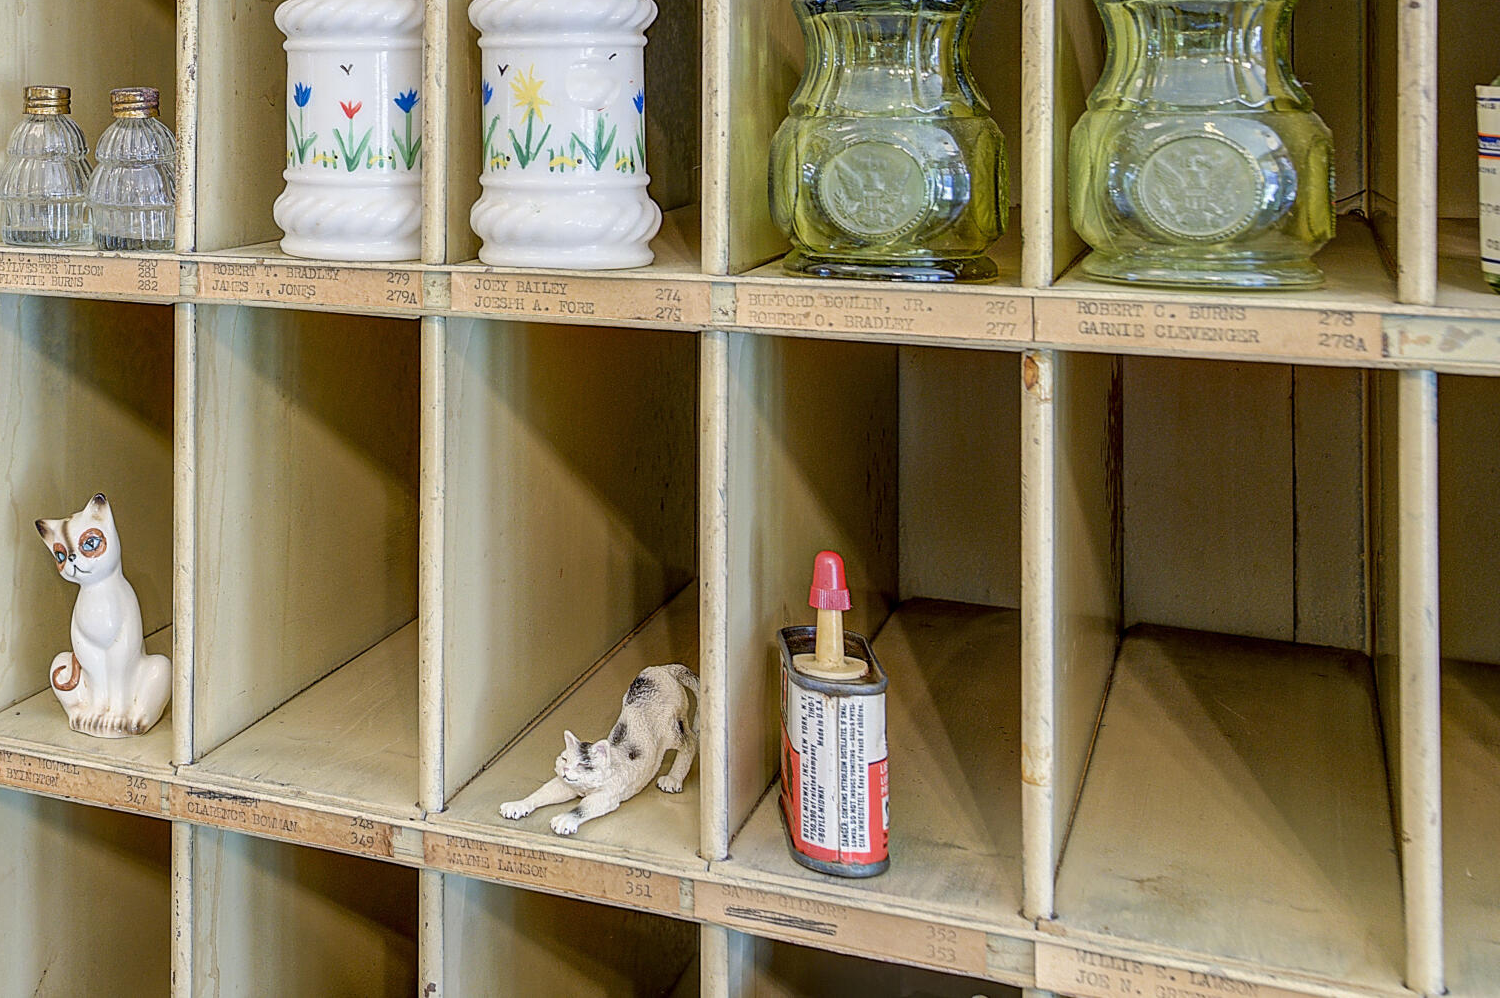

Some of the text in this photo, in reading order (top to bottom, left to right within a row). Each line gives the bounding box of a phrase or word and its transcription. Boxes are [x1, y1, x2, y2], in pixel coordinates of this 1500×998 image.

[63, 265, 158, 279] WILSON 281
[213, 263, 410, 285] ROBERT BRADLEY 279
[51, 276, 159, 292] BURNS 282
[211, 280, 417, 305] JAMES JONES 279A
[474, 278, 681, 302] JOEY BAILEY 274
[474, 296, 595, 315] JOESPH FORE
[986, 301, 1017, 315] 276
[1077, 301, 1354, 326] ROBERT BURNS 278
[844, 315, 1017, 336] BRADLEY 277
[1077, 321, 1367, 352] GARNIE CLEVENGER 278A
[6, 767, 148, 806] BYINGTON 347
[126, 775, 148, 790] 346
[252, 812, 375, 847] BOWMAN 349
[446, 852, 549, 880] WAYNE LAWSON
[625, 881, 653, 899] 351
[926, 925, 958, 944] 352
[927, 944, 958, 963] 353
[1074, 969, 1143, 995] JOE N.
